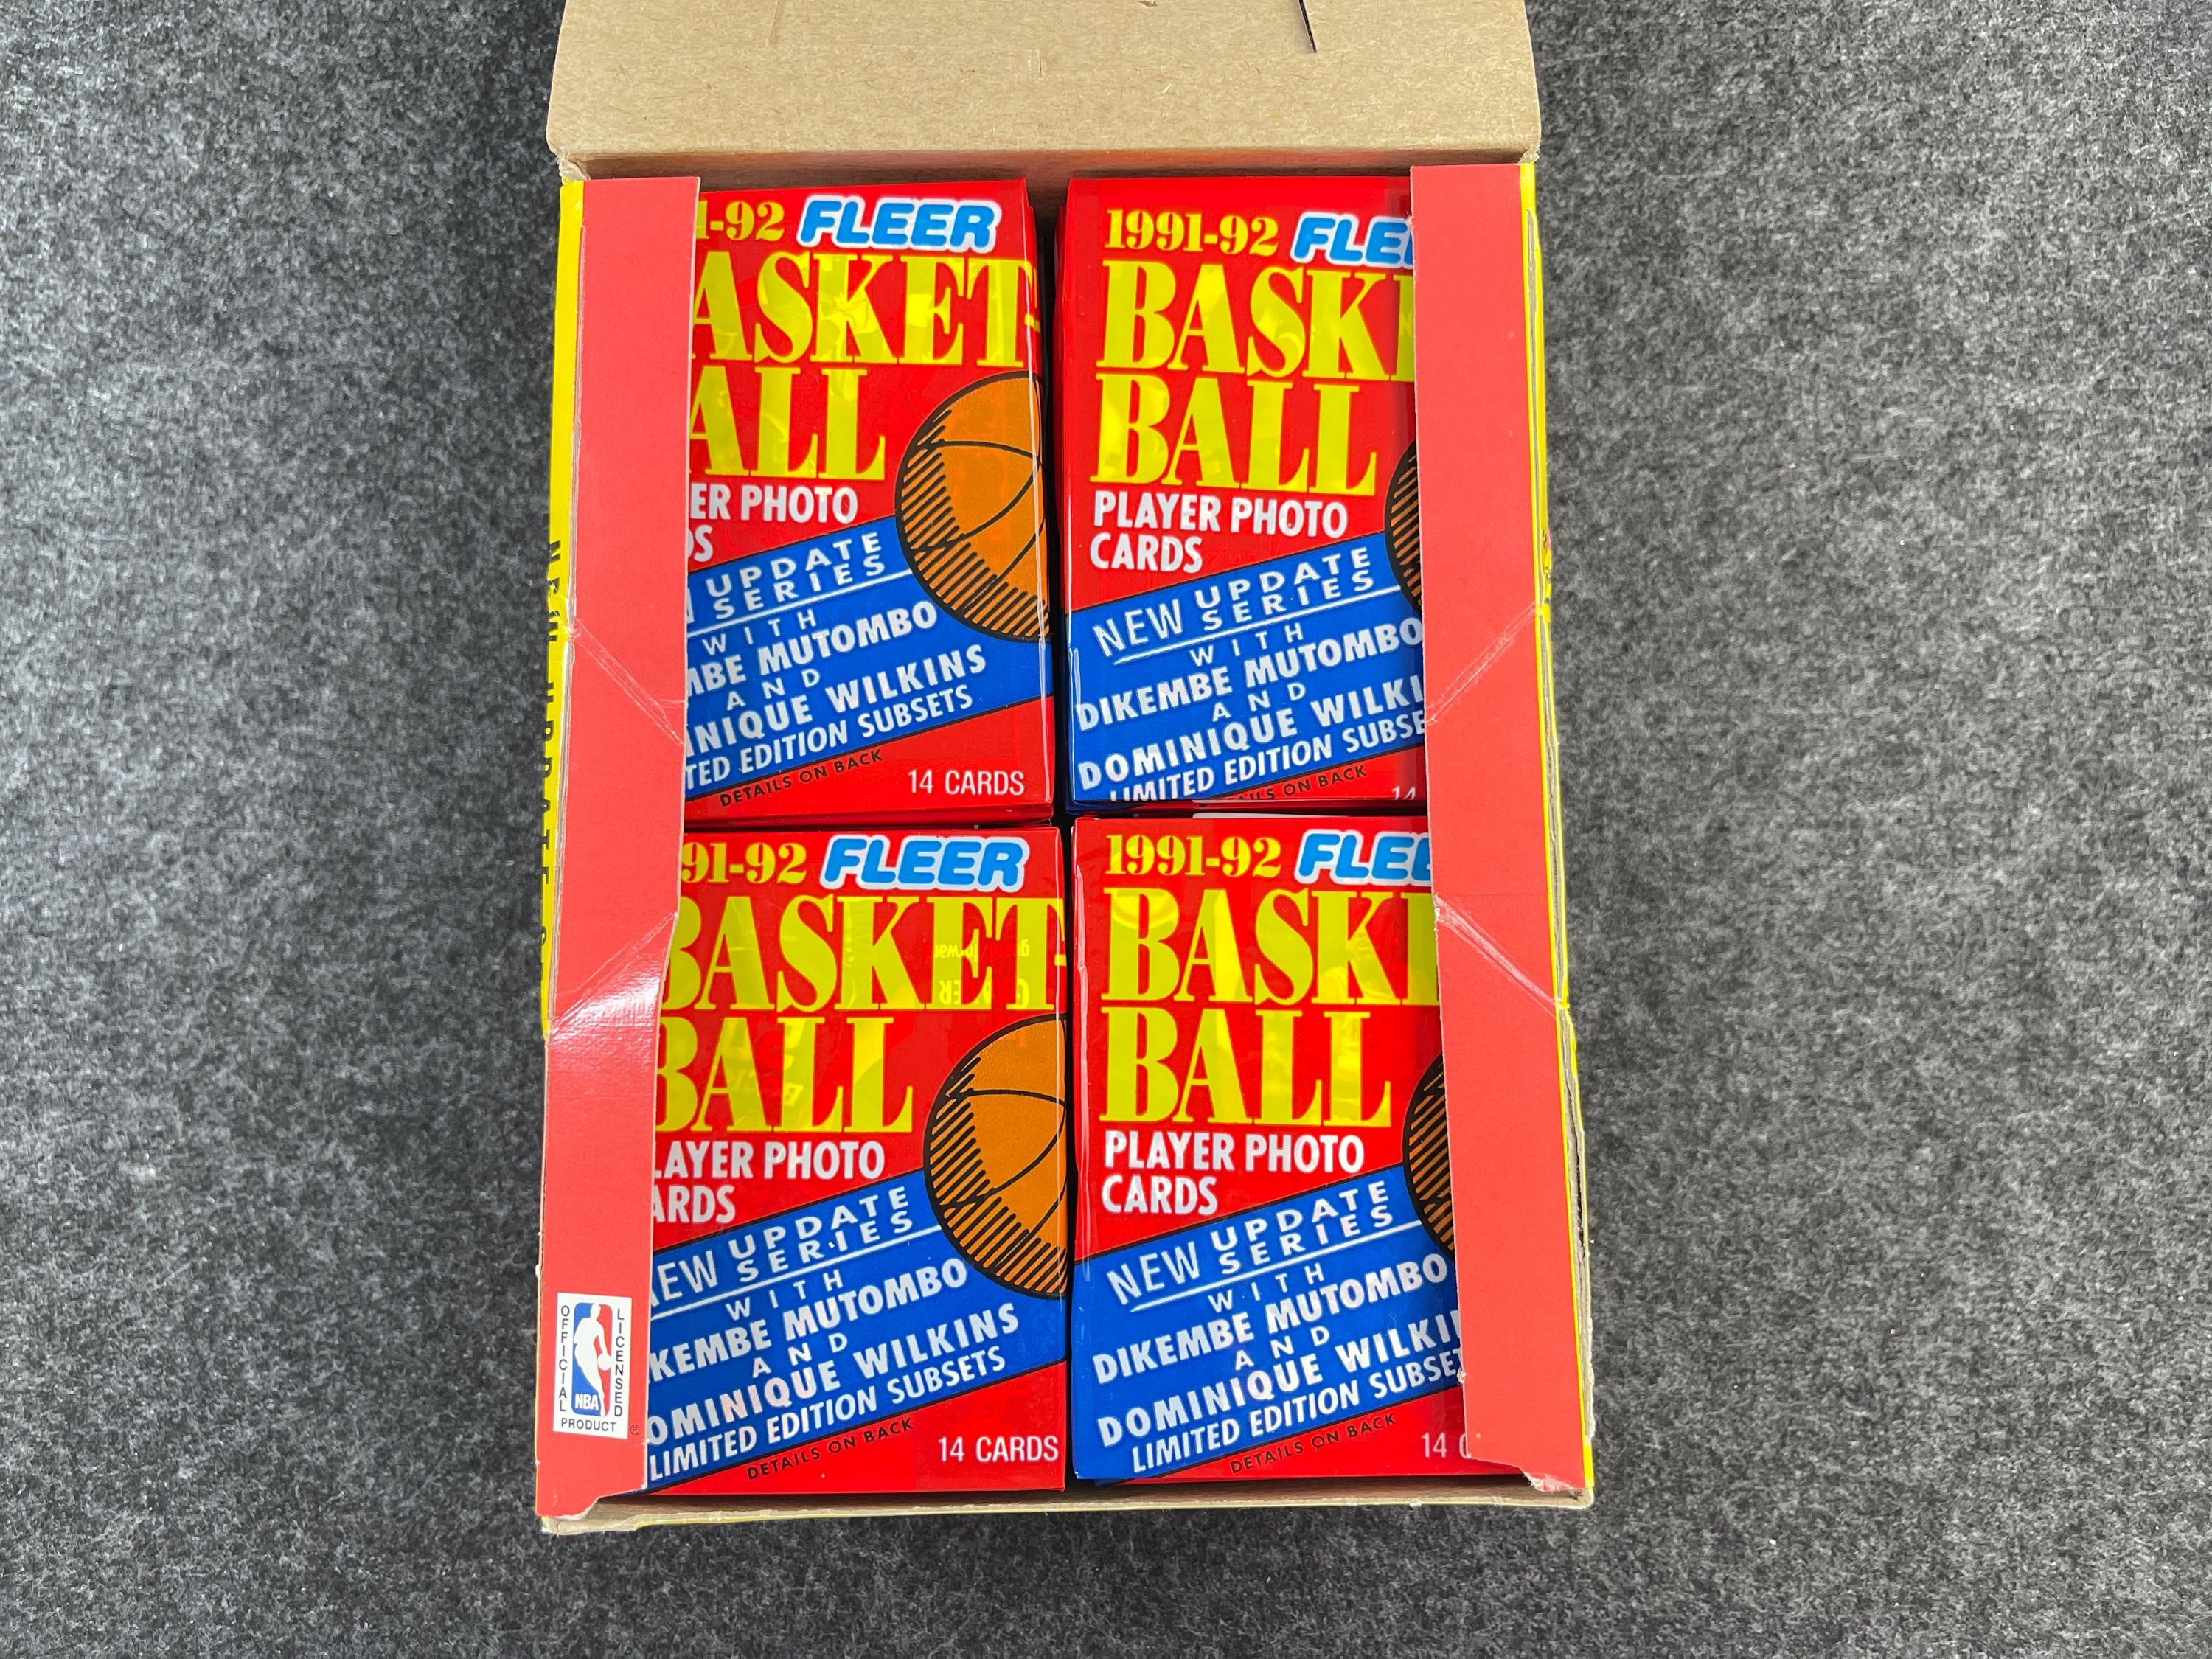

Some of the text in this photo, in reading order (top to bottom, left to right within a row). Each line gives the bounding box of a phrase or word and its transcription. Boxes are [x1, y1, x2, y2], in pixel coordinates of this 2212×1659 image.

[799, 196, 1001, 251] FLEER
[1105, 209, 1414, 268] 1991-92 FLE
[689, 366, 885, 480] ALL
[1089, 372, 1377, 496] BALL
[741, 484, 858, 524] PHOTO
[1094, 490, 1348, 538] PLAYER PHOTO
[706, 532, 882, 597] UPDATE
[1090, 533, 1203, 574] CARDS
[714, 554, 885, 619] SERIES
[1092, 546, 1371, 658] NEW UPDATE
[1200, 569, 1374, 632] SERIES
[701, 608, 816, 656] WITH
[758, 600, 937, 677] MUTOMBO
[1189, 622, 1303, 667] WITH
[726, 668, 821, 712] AND
[826, 644, 987, 713] WILKINS
[1075, 617, 1423, 732] DIKEMBE MUTOMBO
[1211, 681, 1307, 723] AND
[740, 720, 848, 775] EDITION
[858, 684, 974, 737] SUBSETS
[1077, 709, 1297, 791] DOMINIQUE
[1225, 735, 1332, 786] EDITION
[719, 749, 883, 807] DETAILS ON BACK
[908, 769, 1025, 796] 14 CARDS
[1283, 779, 1310, 796] ON
[1318, 764, 1367, 787] BACK
[820, 835, 1030, 892] FLEER
[1105, 834, 1282, 878] 1991-92
[655, 1018, 913, 1133] BALL
[1099, 1007, 1392, 1127] BALL
[655, 1141, 885, 1180] AYER PHOTO
[1106, 1130, 1364, 1172] PLAYER PHOTO
[728, 1186, 908, 1256] UPDATE
[1102, 1175, 1217, 1215] CARDS
[737, 1211, 913, 1283] SERIES
[1107, 1181, 1389, 1305] NEW UPDATE
[1220, 1205, 1393, 1276] SERIES
[725, 1269, 844, 1321] WITH
[782, 1259, 967, 1340] MUTOMBO
[1208, 1262, 1324, 1312] WITH
[853, 1303, 1019, 1380] WILKINS
[1092, 1253, 1447, 1385] DIKEMBE MUTOMBO
[1234, 1326, 1329, 1371] AND
[559, 1305, 570, 1412] OFFICIAL
[614, 1308, 625, 1417] LICENSED
[751, 1332, 848, 1377] AND
[561, 1417, 617, 1432] PRODUCT
[575, 1393, 599, 1410] NBA
[650, 1346, 1006, 1481] LIMITED EDITION SUBSETS
[1097, 1354, 1322, 1447] DOMINIQUE
[1132, 1419, 1239, 1474] LIMITED
[1251, 1379, 1359, 1437] EDITION
[746, 1417, 914, 1481] DETAILS ON BACK
[937, 1436, 1059, 1462] 14 CARDS
[1231, 1412, 1397, 1475] DETAILS ON BACK
[1421, 1433, 1447, 1458] 14
